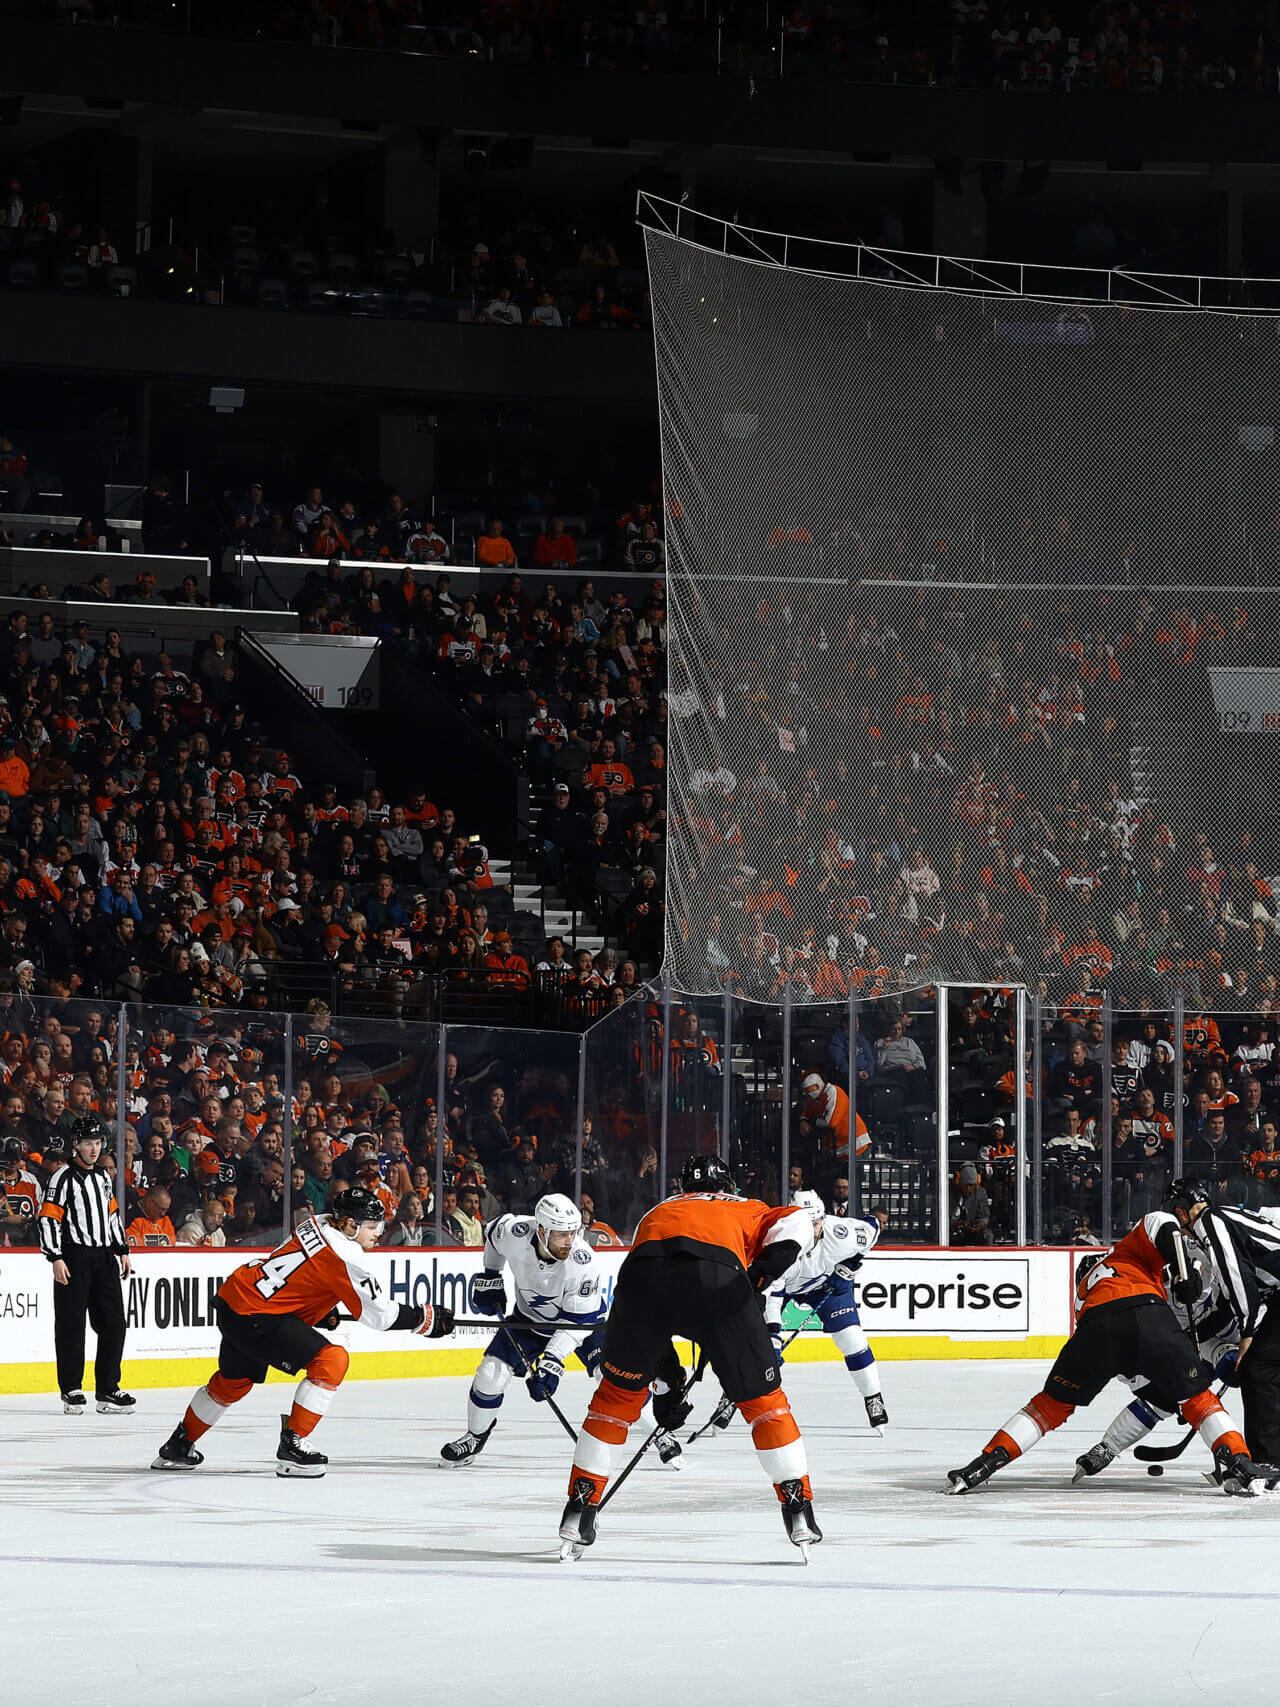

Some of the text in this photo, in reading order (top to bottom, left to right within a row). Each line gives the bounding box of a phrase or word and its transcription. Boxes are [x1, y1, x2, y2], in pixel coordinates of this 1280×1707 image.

[337, 687, 373, 707] 109
[694, 1168, 701, 1179] 6
[248, 1249, 309, 1300] 4
[359, 1276, 382, 1300] 74
[0, 1293, 38, 1319] ASH
[127, 1277, 150, 1329] AY
[830, 1307, 855, 1319] CCM
